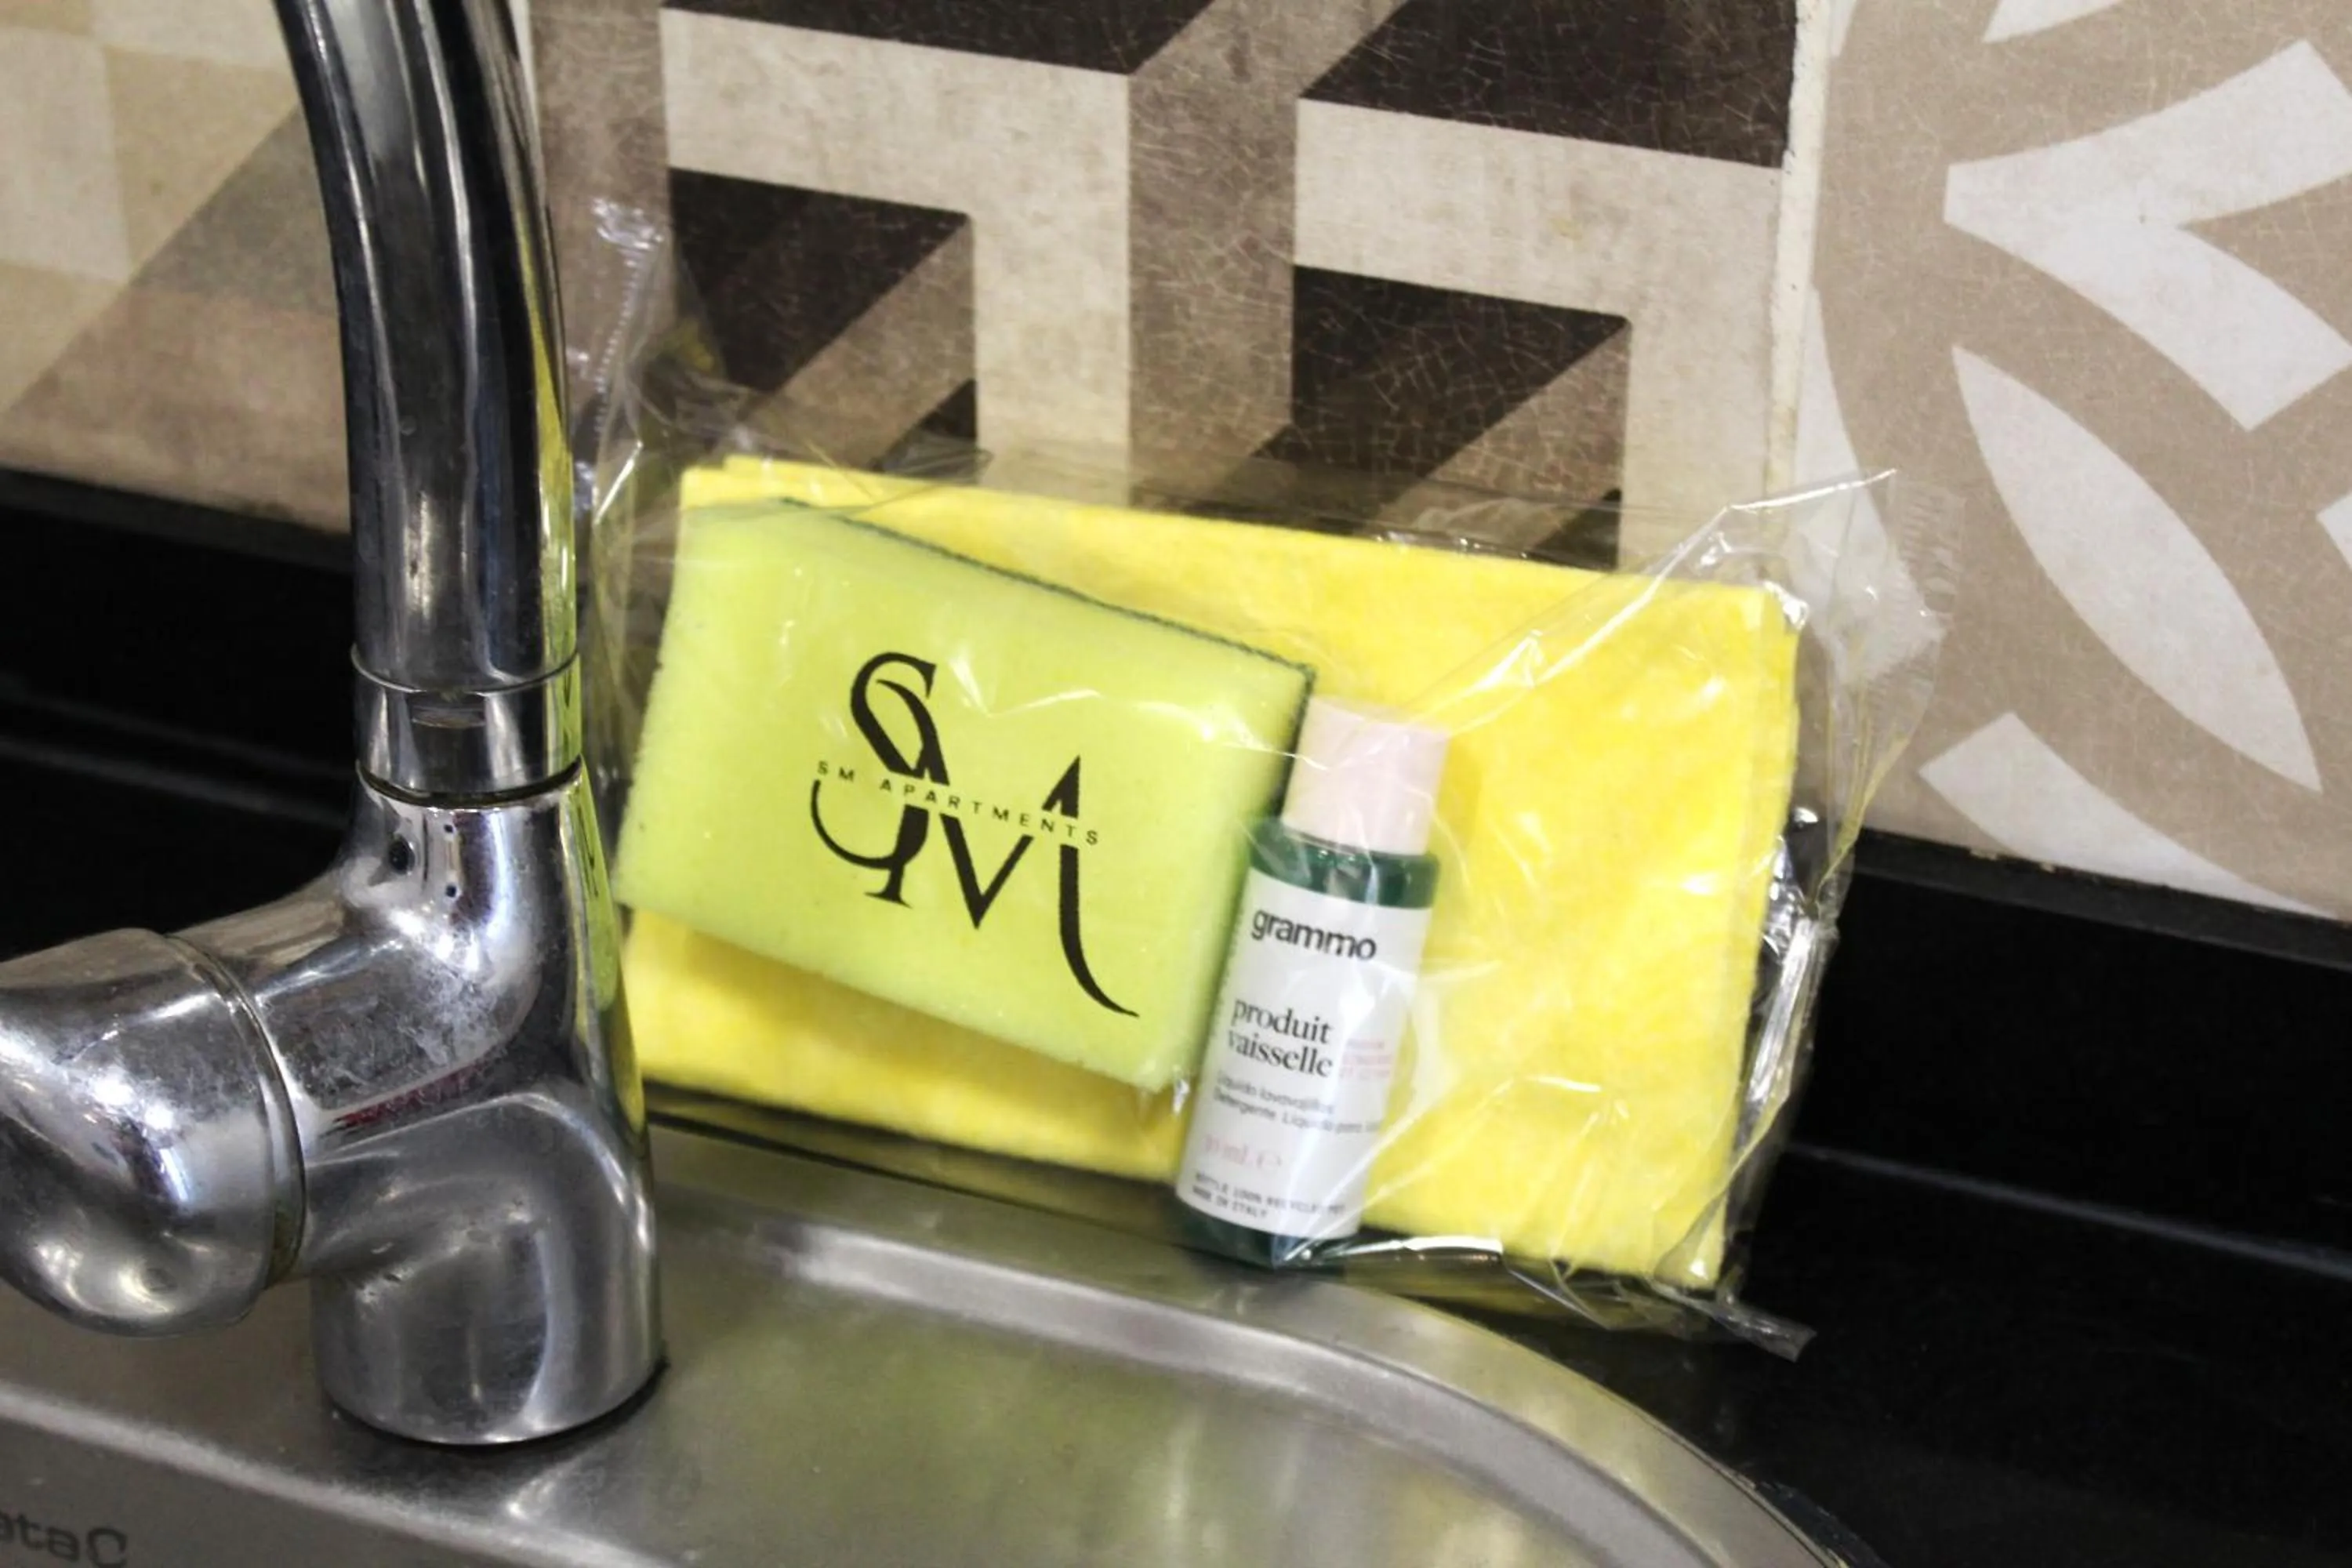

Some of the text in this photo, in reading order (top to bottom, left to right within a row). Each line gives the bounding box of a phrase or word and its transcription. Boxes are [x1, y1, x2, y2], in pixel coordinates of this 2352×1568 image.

[817, 760, 1099, 846] SM APARTMENTS
[1251, 909, 1377, 961] grammo
[1231, 998, 1334, 1044] produit
[1228, 1029, 1334, 1078] vaisselle
